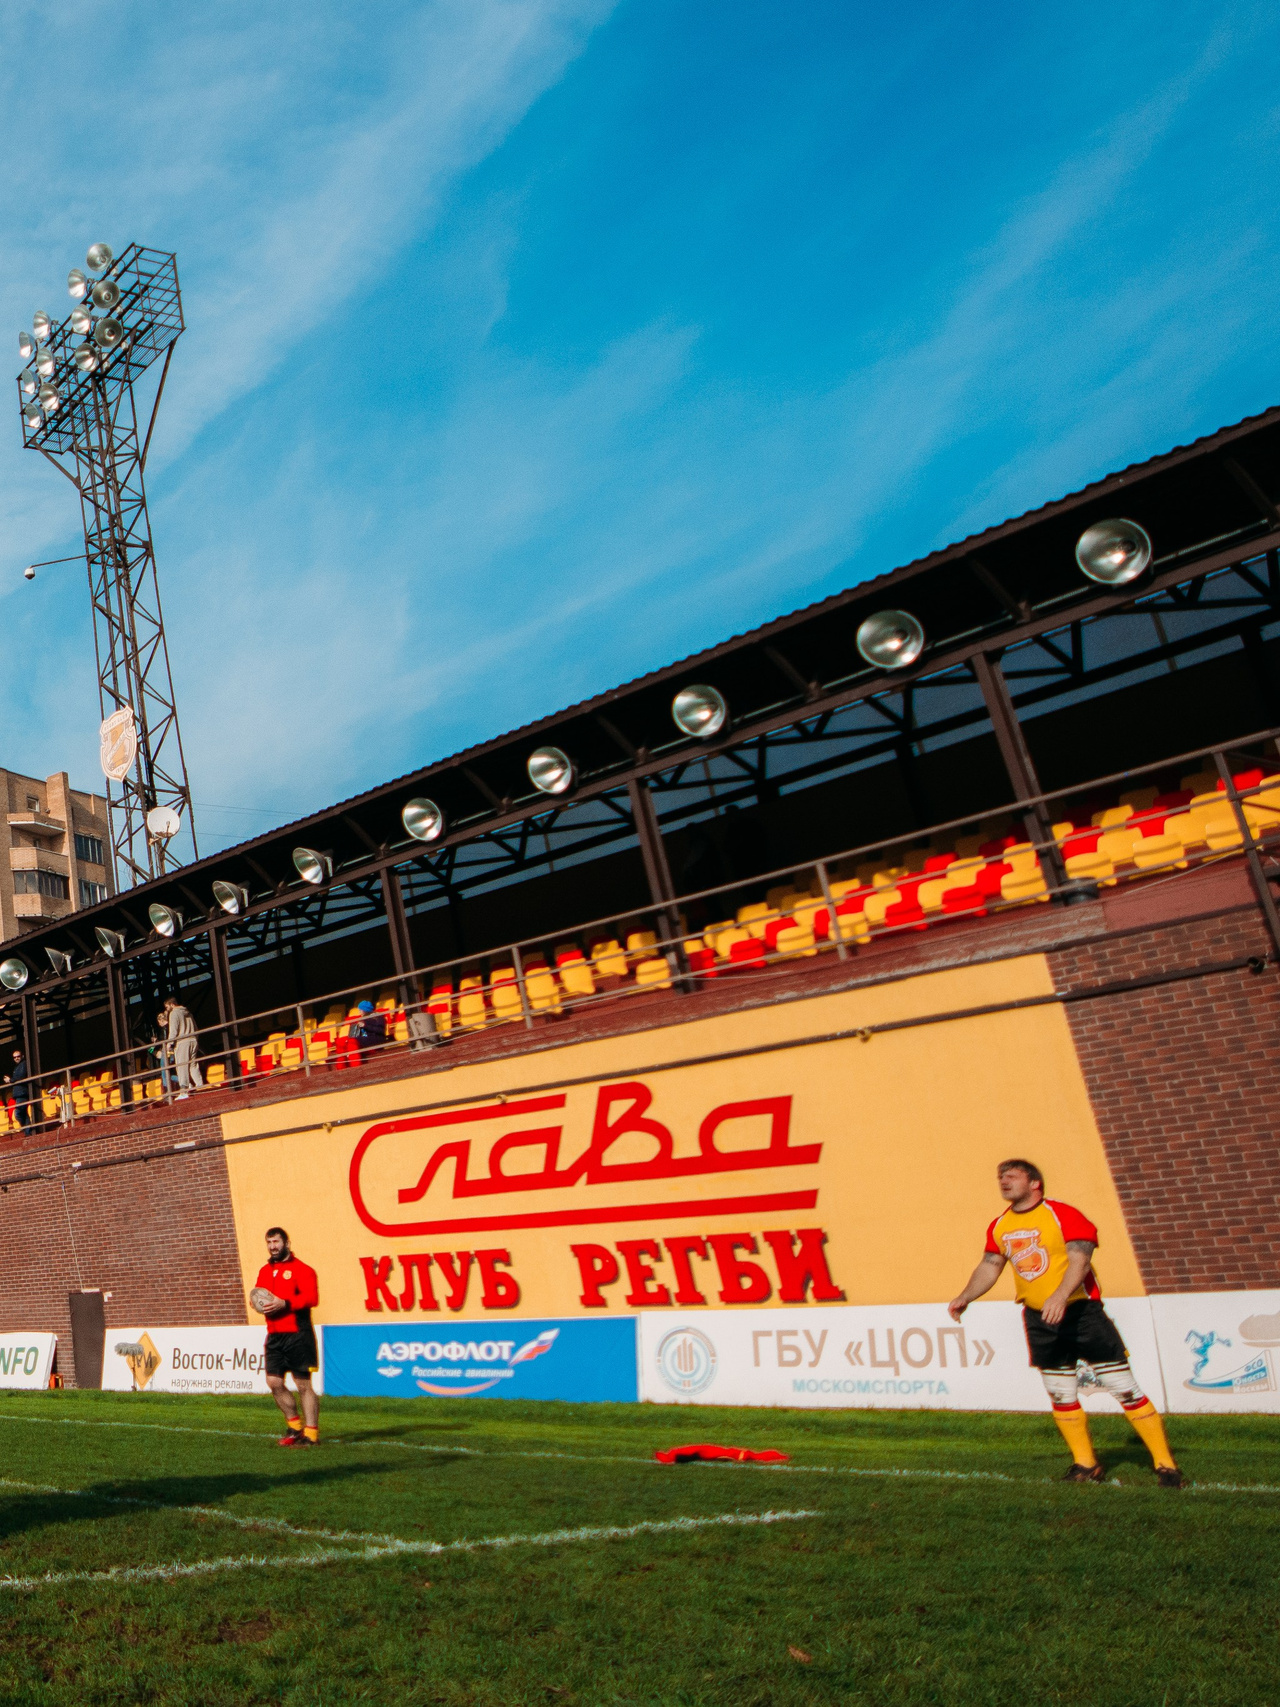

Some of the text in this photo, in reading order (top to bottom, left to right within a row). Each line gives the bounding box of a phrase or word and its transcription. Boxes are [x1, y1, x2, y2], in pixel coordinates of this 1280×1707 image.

[359, 1228, 847, 1312] КЛУБ РЕГБИ
[172, 1347, 265, 1375] Восток-Мед
[376, 1340, 516, 1362] АЭРОФЛОТ
[751, 1326, 996, 1377] ГБУ «ЦОП»
[412, 1366, 514, 1378] Российские авиалинии
[171, 1378, 253, 1391] наружная реклама
[792, 1378, 950, 1395] МОСКОМСПОРТА
